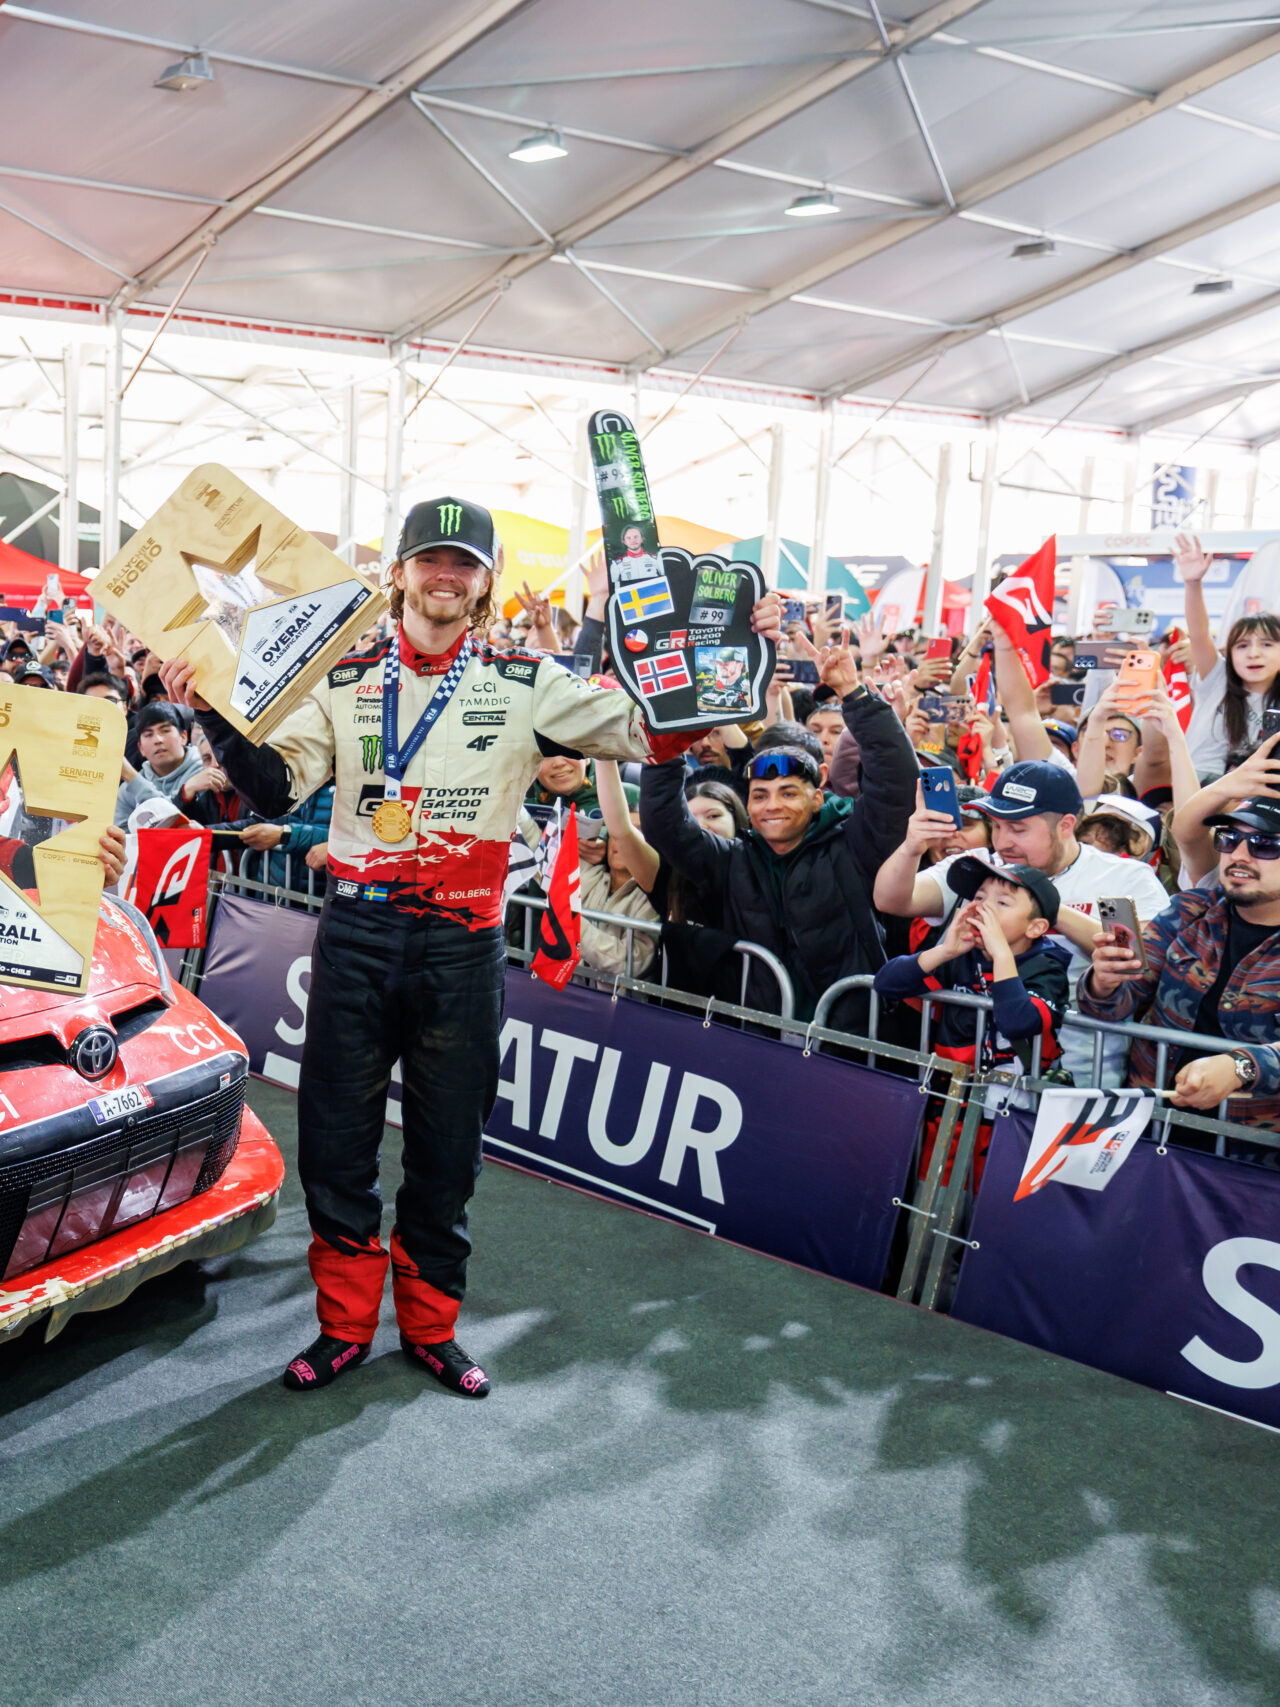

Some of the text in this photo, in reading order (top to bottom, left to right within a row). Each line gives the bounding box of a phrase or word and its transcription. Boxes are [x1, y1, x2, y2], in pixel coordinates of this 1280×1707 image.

[621, 431, 651, 519] OLIVER SOLBERG
[106, 536, 156, 591] RALLYCHILE
[702, 569, 738, 588] OLIVER
[697, 584, 737, 603] SOLBERG
[700, 610, 723, 621] # 99
[261, 602, 322, 663] OVERALL
[688, 626, 725, 635] TOYOTA
[688, 633, 721, 641] GAZOO
[269, 621, 313, 667] CLASSIFICATION
[656, 637, 687, 650] GR
[688, 639, 720, 647] Racing
[332, 669, 358, 681] OMP
[505, 664, 532, 677] OMP
[245, 679, 271, 706] PLACE
[458, 696, 511, 707] TAMADIC
[466, 734, 499, 752] 4F
[59, 765, 104, 781] SERNATUR
[387, 790, 396, 798] FIA
[424, 786, 489, 798] TOYOTA
[421, 798, 481, 809] GAZOO
[419, 809, 477, 822] Racing
[337, 882, 359, 896] OMP
[435, 887, 491, 901] O. SOLBERG
[16, 911, 27, 919] FIA
[11, 968, 32, 977] CHILE
[275, 955, 742, 1204] SATUR
[104, 1091, 142, 1117] A-7662
[289, 1360, 314, 1382] OMP
